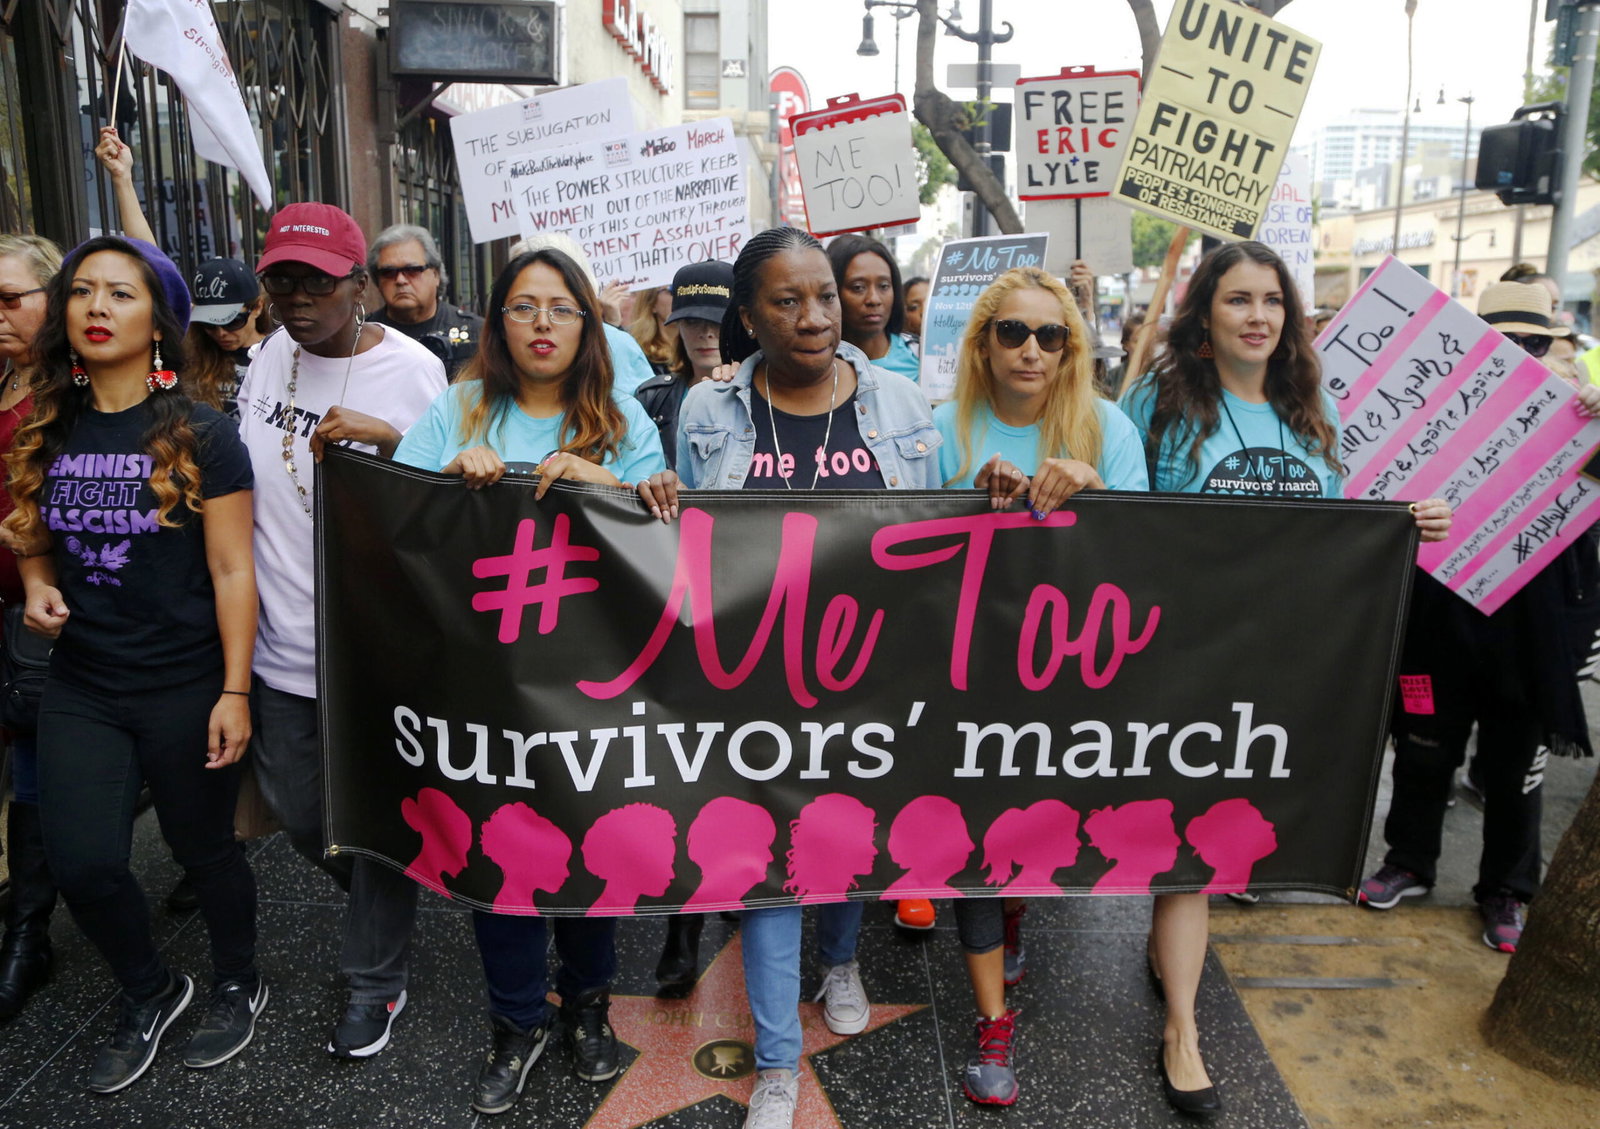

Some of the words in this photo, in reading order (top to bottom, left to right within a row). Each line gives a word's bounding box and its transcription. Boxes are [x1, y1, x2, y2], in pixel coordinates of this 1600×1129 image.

[183, 28, 232, 78] Stronger
[1179, 0, 1314, 84] UNITE
[1024, 91, 1125, 125] FREE
[1206, 67, 1254, 114] TO
[465, 135, 499, 157] THE
[506, 109, 611, 147] SUBJUGATION
[687, 130, 725, 150] MARCH
[1037, 127, 1119, 155] ERIC
[1149, 102, 1275, 175] FIGHT
[484, 160, 506, 176] OF
[521, 186, 550, 206] THE
[556, 174, 611, 203] POWER
[615, 161, 694, 189] STRUCTURE
[701, 153, 738, 173] KEEPS
[815, 136, 866, 178] ME
[1028, 161, 1099, 187] LYLE
[1129, 137, 1269, 206] PATRIARCHY
[530, 203, 594, 231] WOMEN
[606, 197, 630, 215] OUT
[636, 193, 652, 210] OF
[653, 189, 673, 204] THE
[675, 174, 738, 202] NARRATIVE
[813, 163, 904, 212] TOO!
[1126, 168, 1189, 201] PEOPLE'S
[1190, 191, 1258, 226] CONGRESS
[292, 225, 330, 236] INTERESTED
[579, 223, 596, 240] OF
[600, 218, 629, 232] THIS
[635, 205, 695, 229] COUNTRY
[699, 196, 746, 216] THROUGH
[1138, 188, 1159, 204] OF
[1158, 194, 1237, 233] RESISTANCE
[1296, 206, 1313, 224] OF
[582, 233, 641, 258] SMENT
[652, 217, 726, 247] ASSAULT
[593, 256, 627, 278] BUT
[629, 247, 670, 272] THAT
[687, 232, 742, 265] OVER
[1257, 228, 1311, 245] LDREN
[940, 272, 997, 283] survivors'
[1322, 287, 1415, 367] Too!
[1377, 358, 1453, 420] Again
[1369, 470, 1405, 501] gain
[1407, 418, 1455, 465] Again
[1458, 370, 1505, 416] Again
[50, 480, 142, 507] FIGHT
[1210, 477, 1276, 492] survivors'
[1279, 480, 1319, 492] march
[1445, 480, 1477, 511] gain
[1473, 438, 1518, 475] Again
[394, 701, 926, 792] survivors'
[954, 702, 1291, 779] march
[637, 1009, 704, 1028] JOHN
